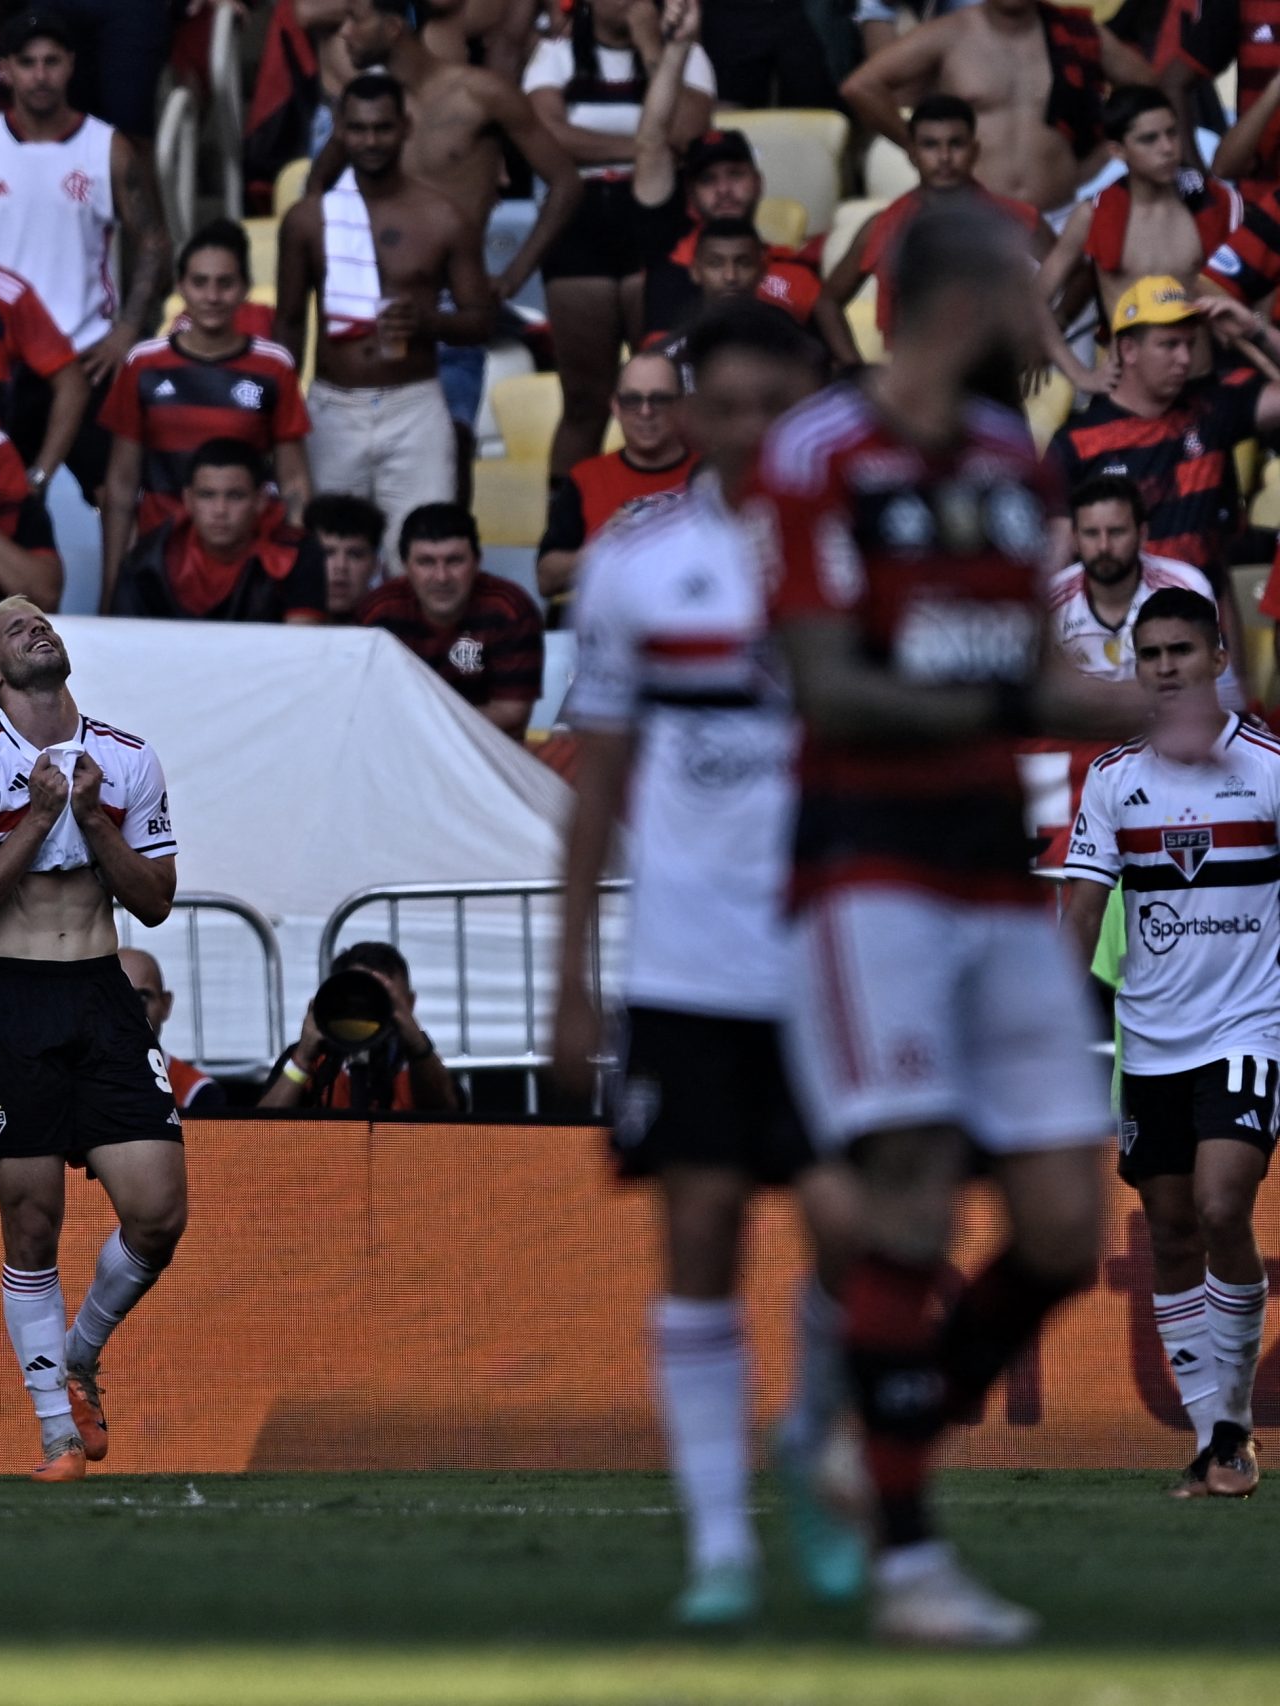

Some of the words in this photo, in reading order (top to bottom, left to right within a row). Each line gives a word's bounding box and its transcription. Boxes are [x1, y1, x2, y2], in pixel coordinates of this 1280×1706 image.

[1166, 832, 1211, 847] SPFC
[1150, 914, 1261, 941] Sportsbet.io
[147, 1048, 173, 1094] 9
[1226, 1055, 1269, 1098] 11
